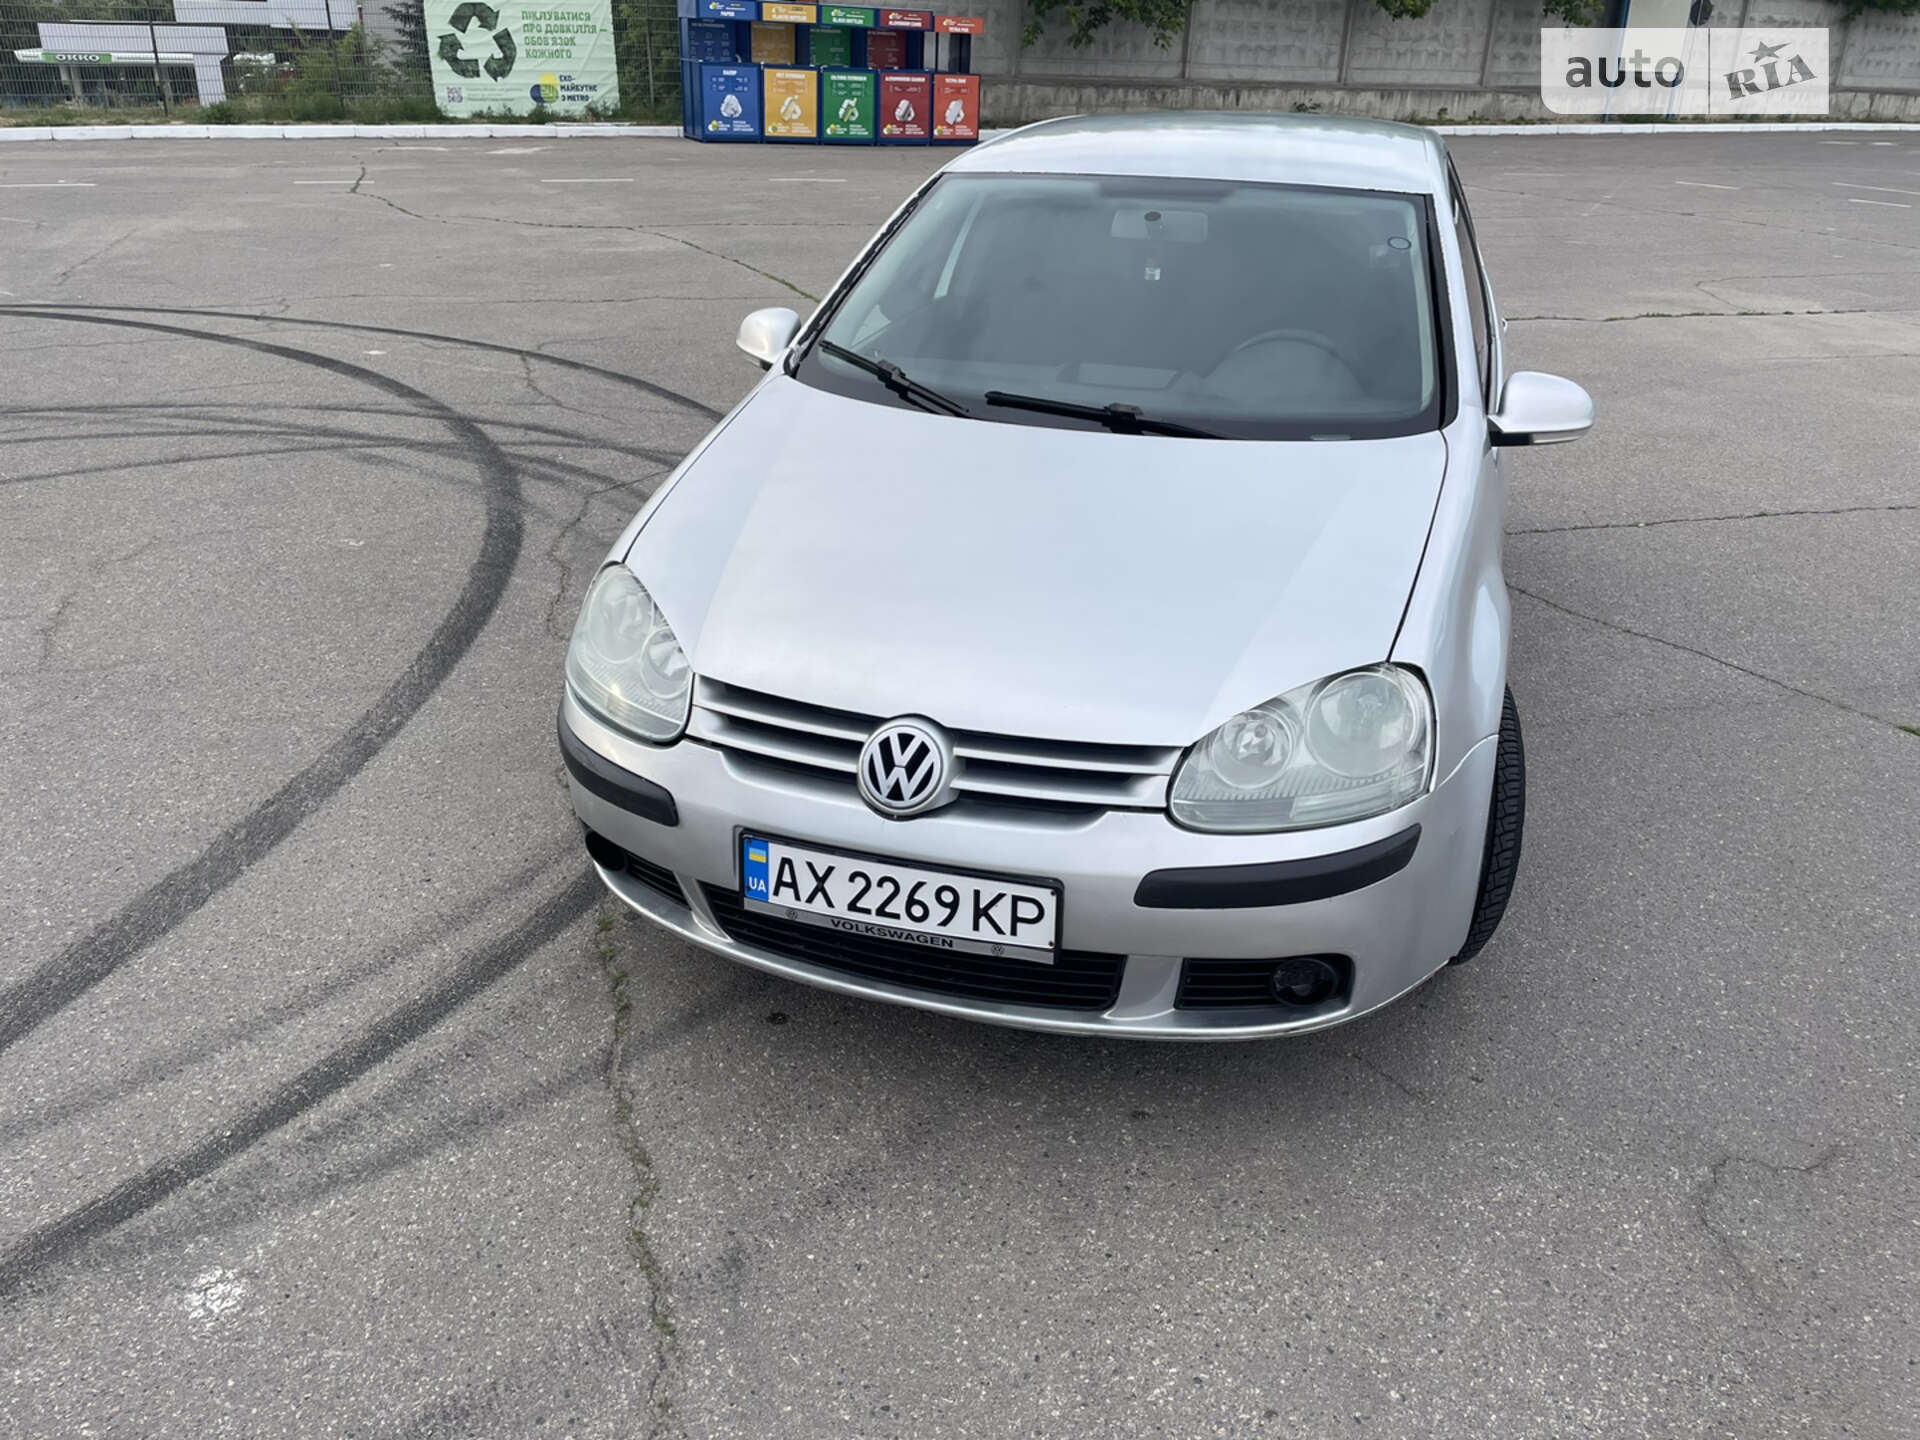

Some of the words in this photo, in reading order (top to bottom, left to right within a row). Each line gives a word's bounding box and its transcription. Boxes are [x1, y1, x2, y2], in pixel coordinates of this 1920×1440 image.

[521, 10, 591, 21] ПІКЛУВАТИСЯ
[522, 24, 542, 33] ПРО
[545, 24, 597, 34] ДОВКІЛЛЯ
[55, 53, 100, 62] OKKO
[526, 49, 572, 59] КОЖНОГО
[749, 877, 767, 893] UA
[772, 856, 836, 909] AX
[846, 870, 961, 927] 2269
[971, 889, 1046, 937] KP
[830, 919, 954, 948] VOLKSWAGEN
